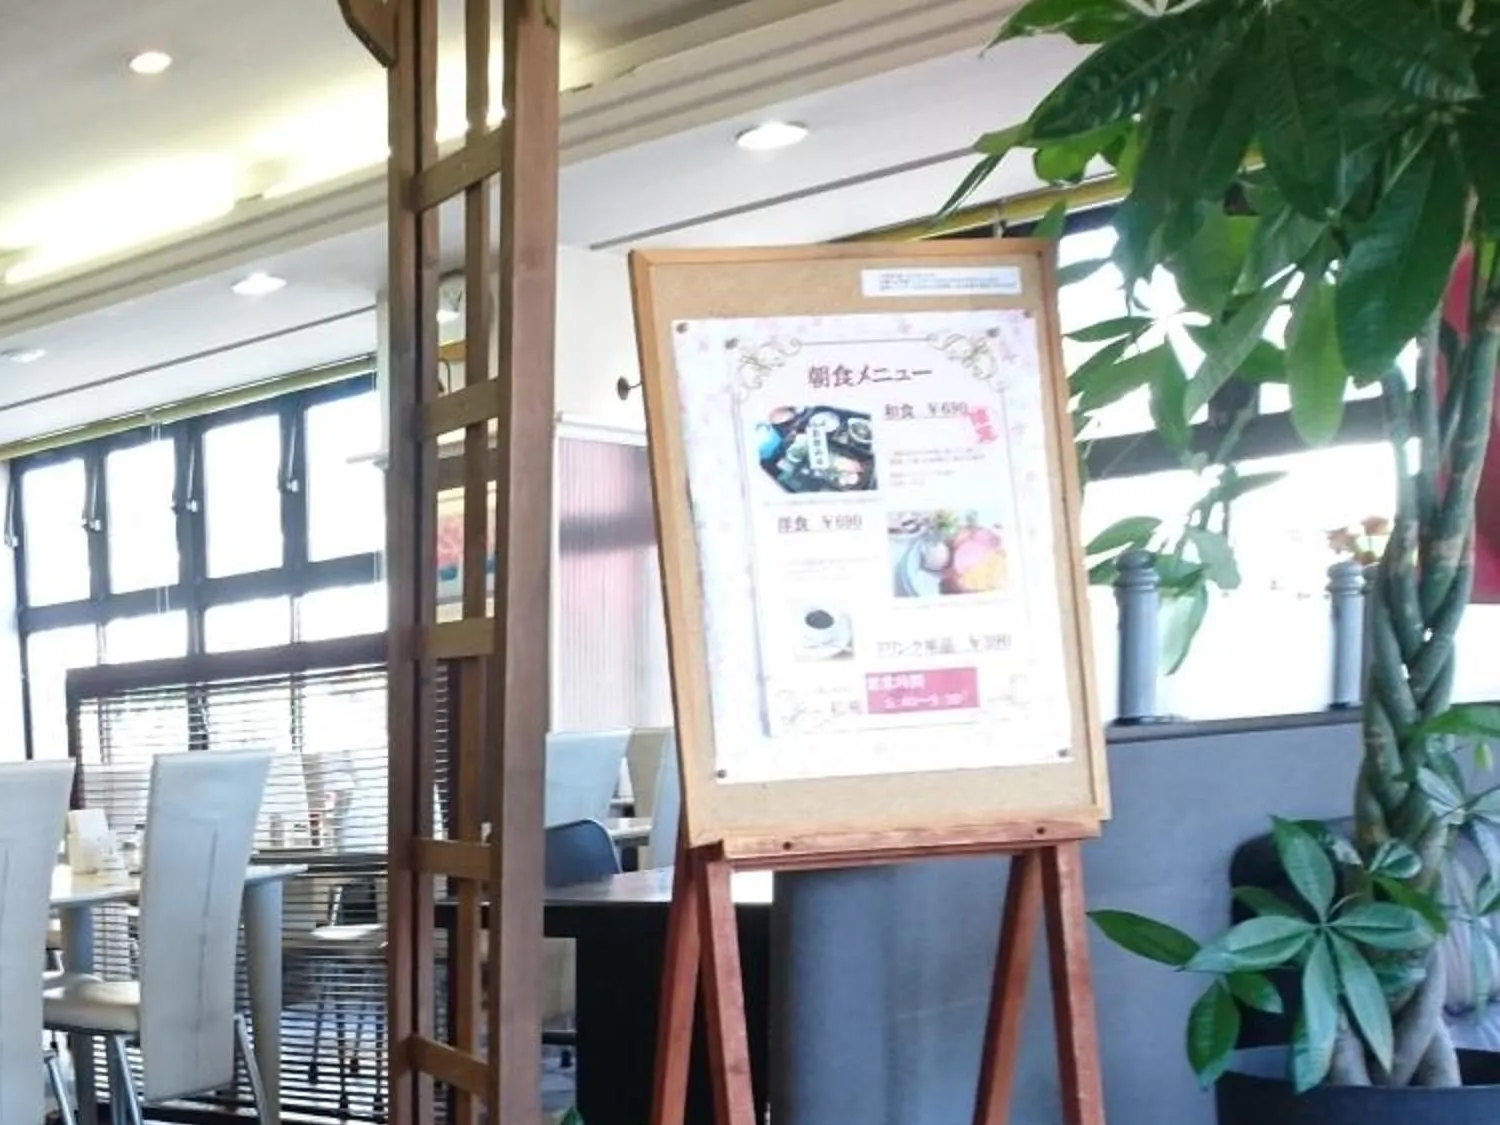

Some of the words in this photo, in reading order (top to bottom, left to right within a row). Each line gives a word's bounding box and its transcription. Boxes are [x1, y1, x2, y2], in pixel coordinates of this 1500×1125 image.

[807, 364, 934, 389] 朝食メニュー
[884, 402, 915, 419] 和食
